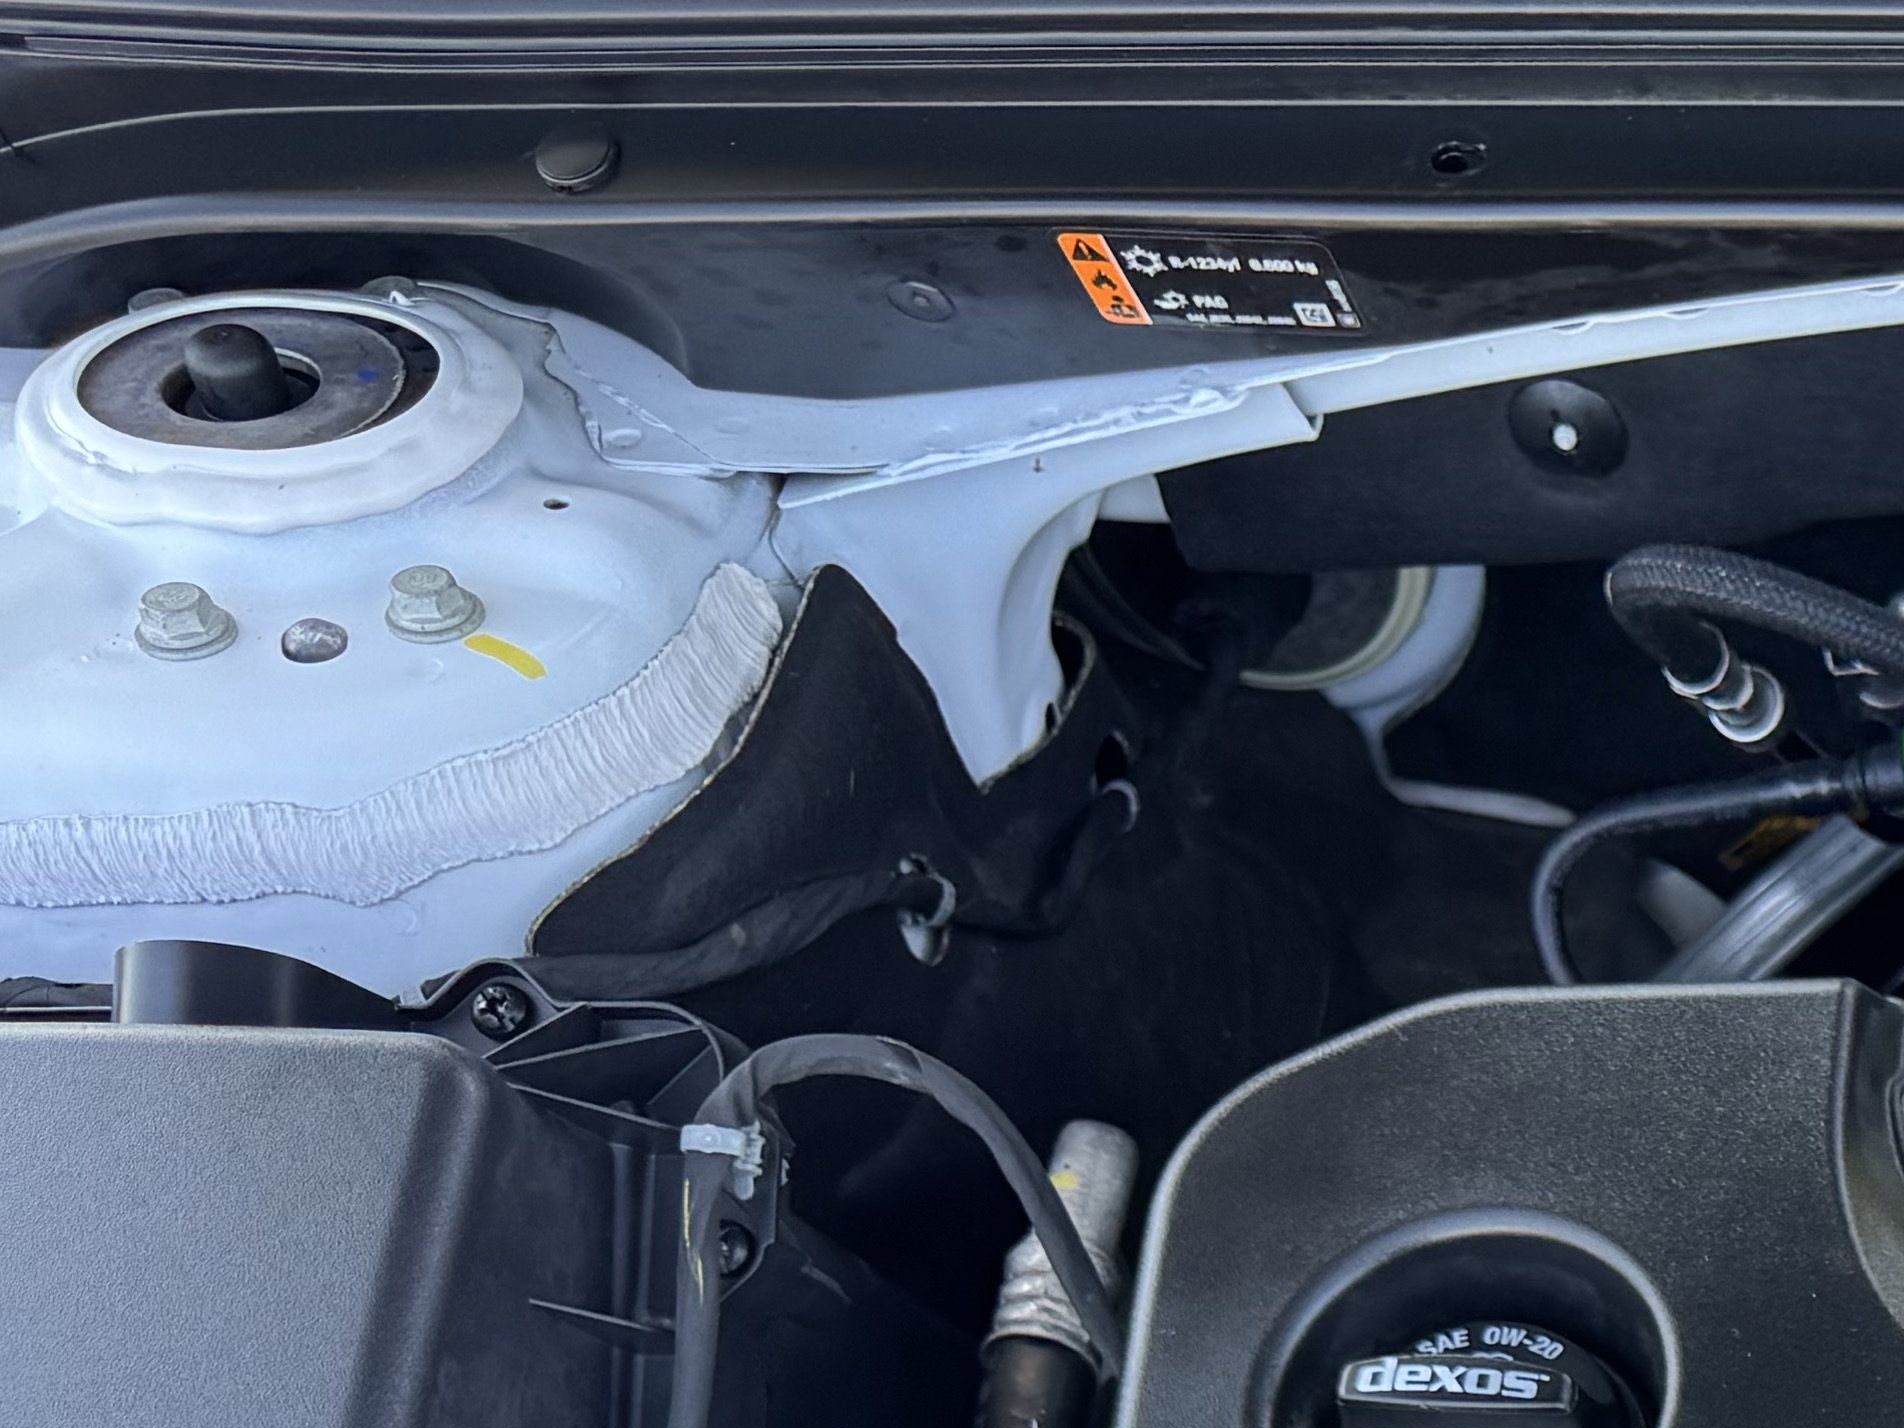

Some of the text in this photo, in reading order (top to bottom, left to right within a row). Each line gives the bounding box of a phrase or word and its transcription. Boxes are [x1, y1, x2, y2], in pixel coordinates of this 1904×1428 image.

[1415, 1325, 1564, 1361] SAE 0W-20
[1356, 1357, 1538, 1398] dexos
